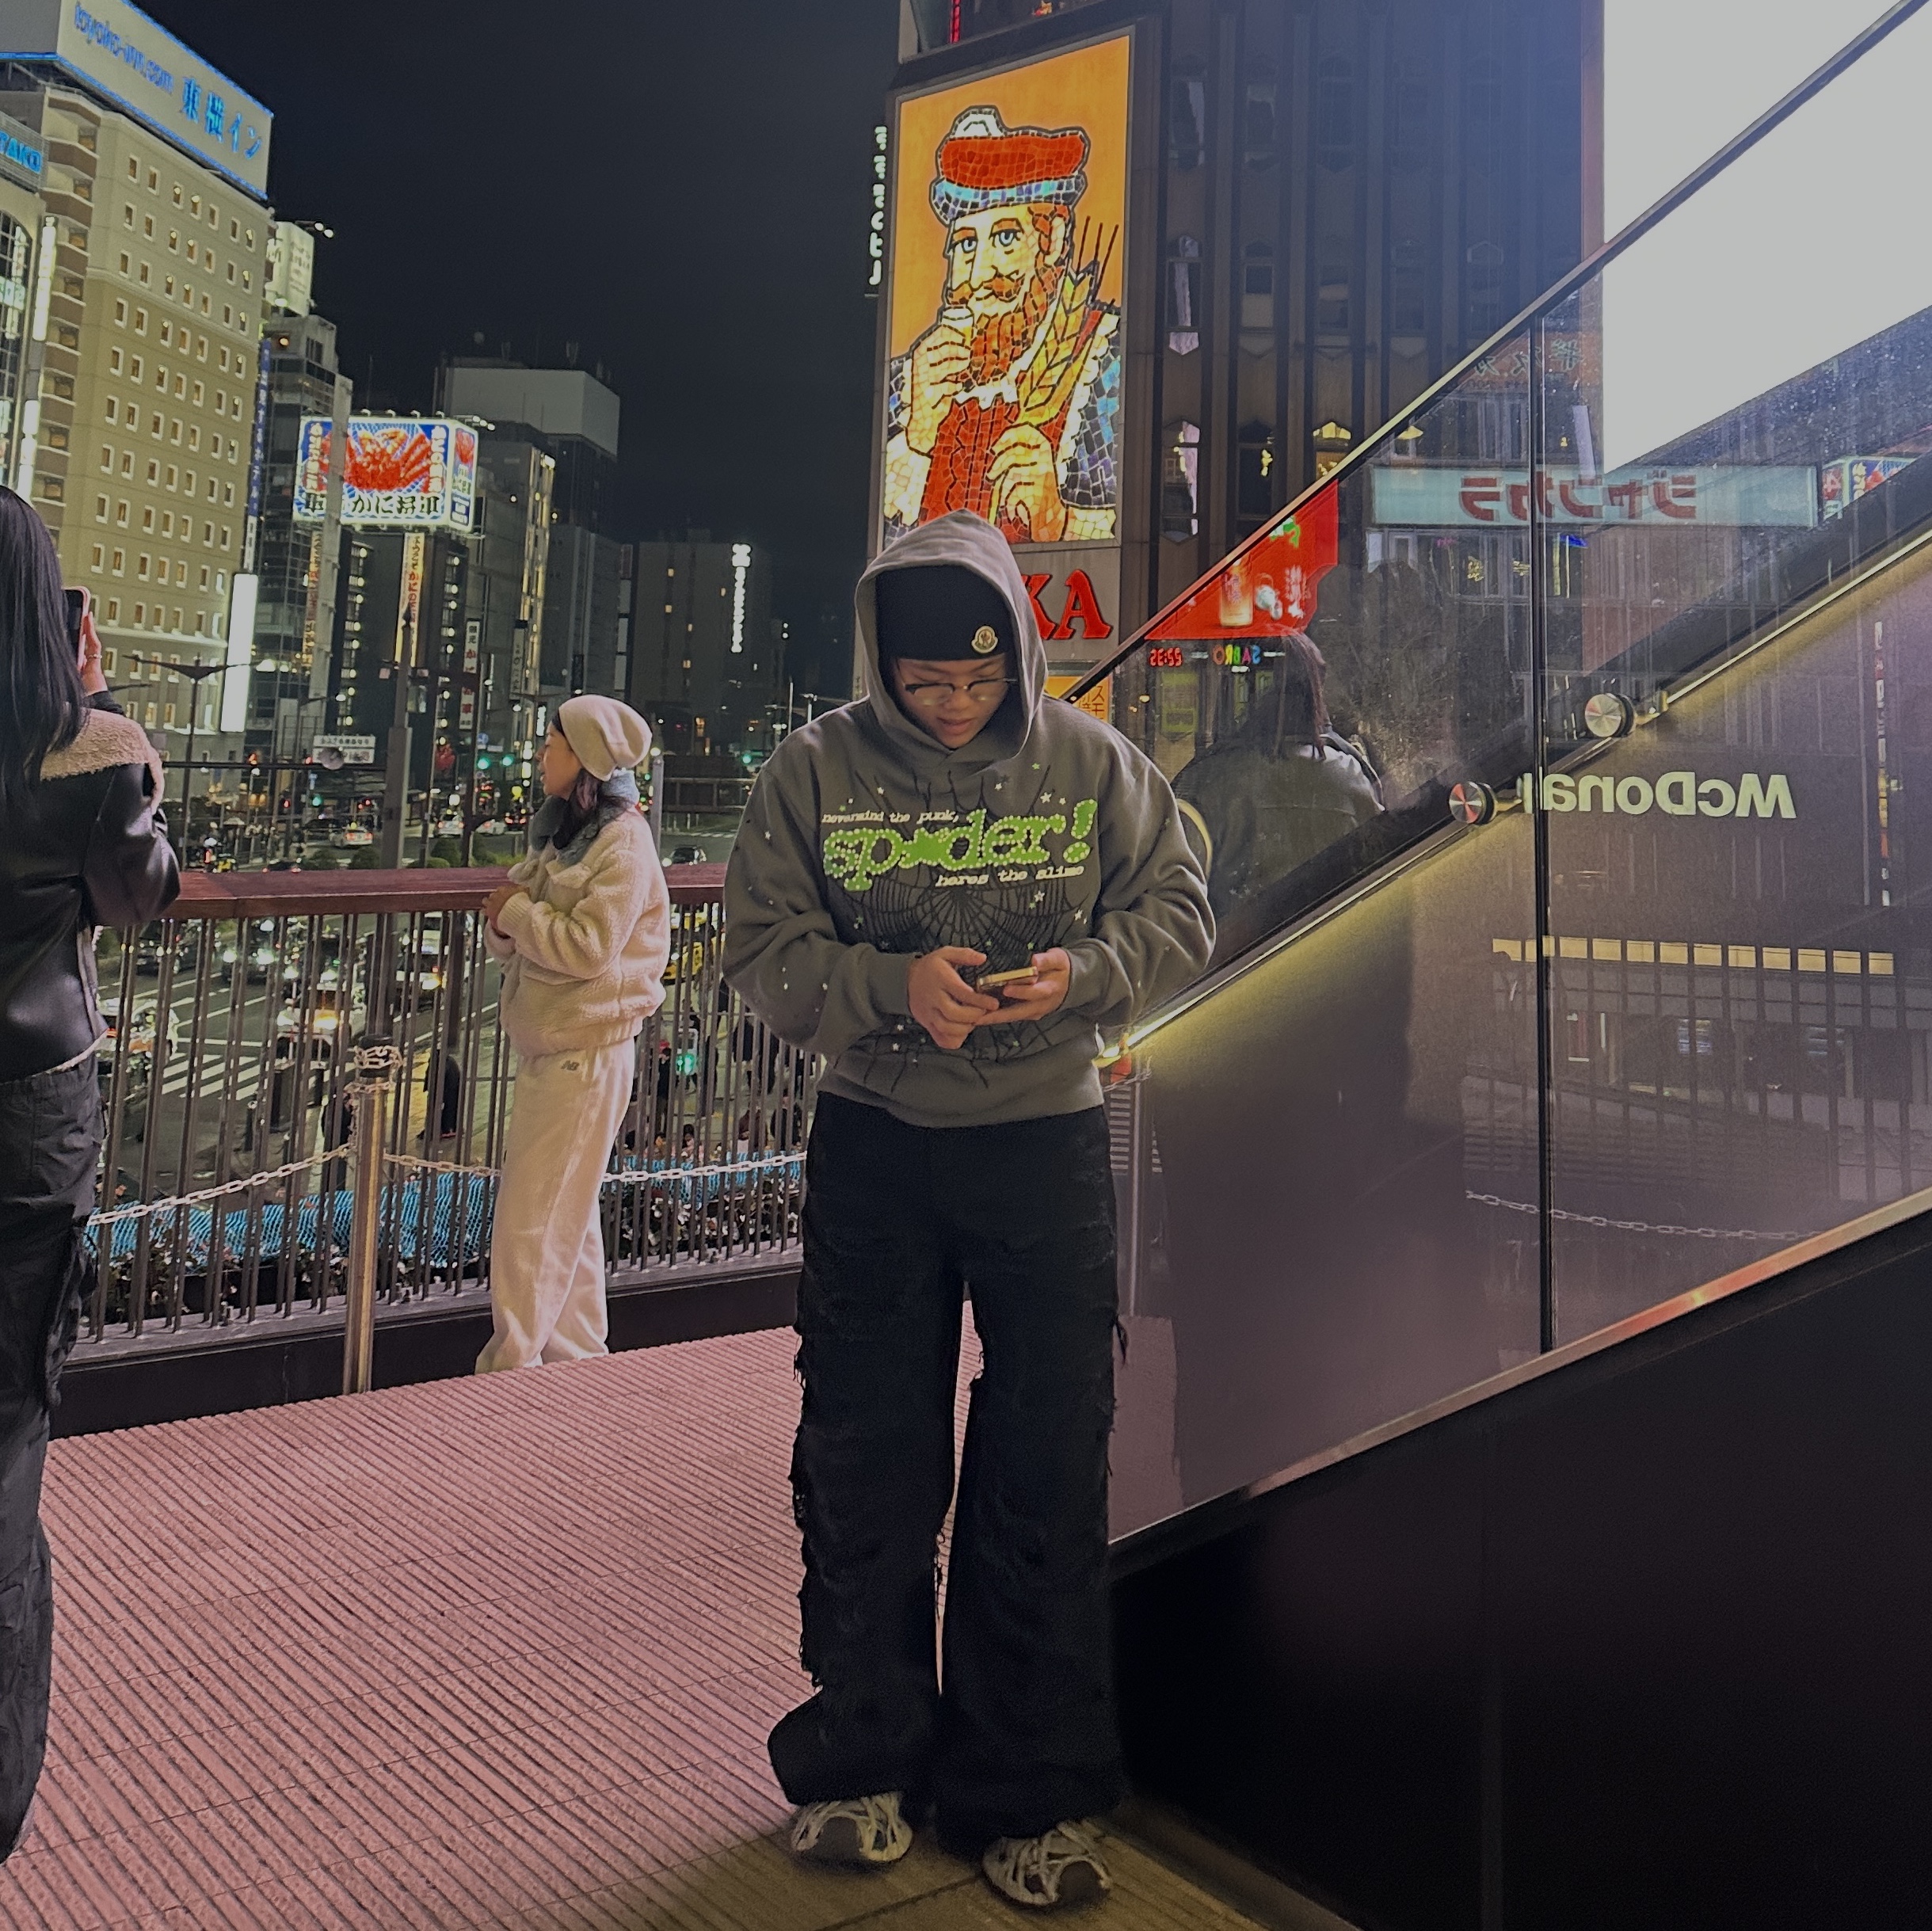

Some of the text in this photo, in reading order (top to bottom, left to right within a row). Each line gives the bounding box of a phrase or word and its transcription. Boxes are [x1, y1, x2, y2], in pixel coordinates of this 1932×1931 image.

[181, 77, 263, 160] 東横イン
[889, 812, 911, 824] the
[998, 869, 1027, 883] the
[1035, 865, 1084, 880] slime
